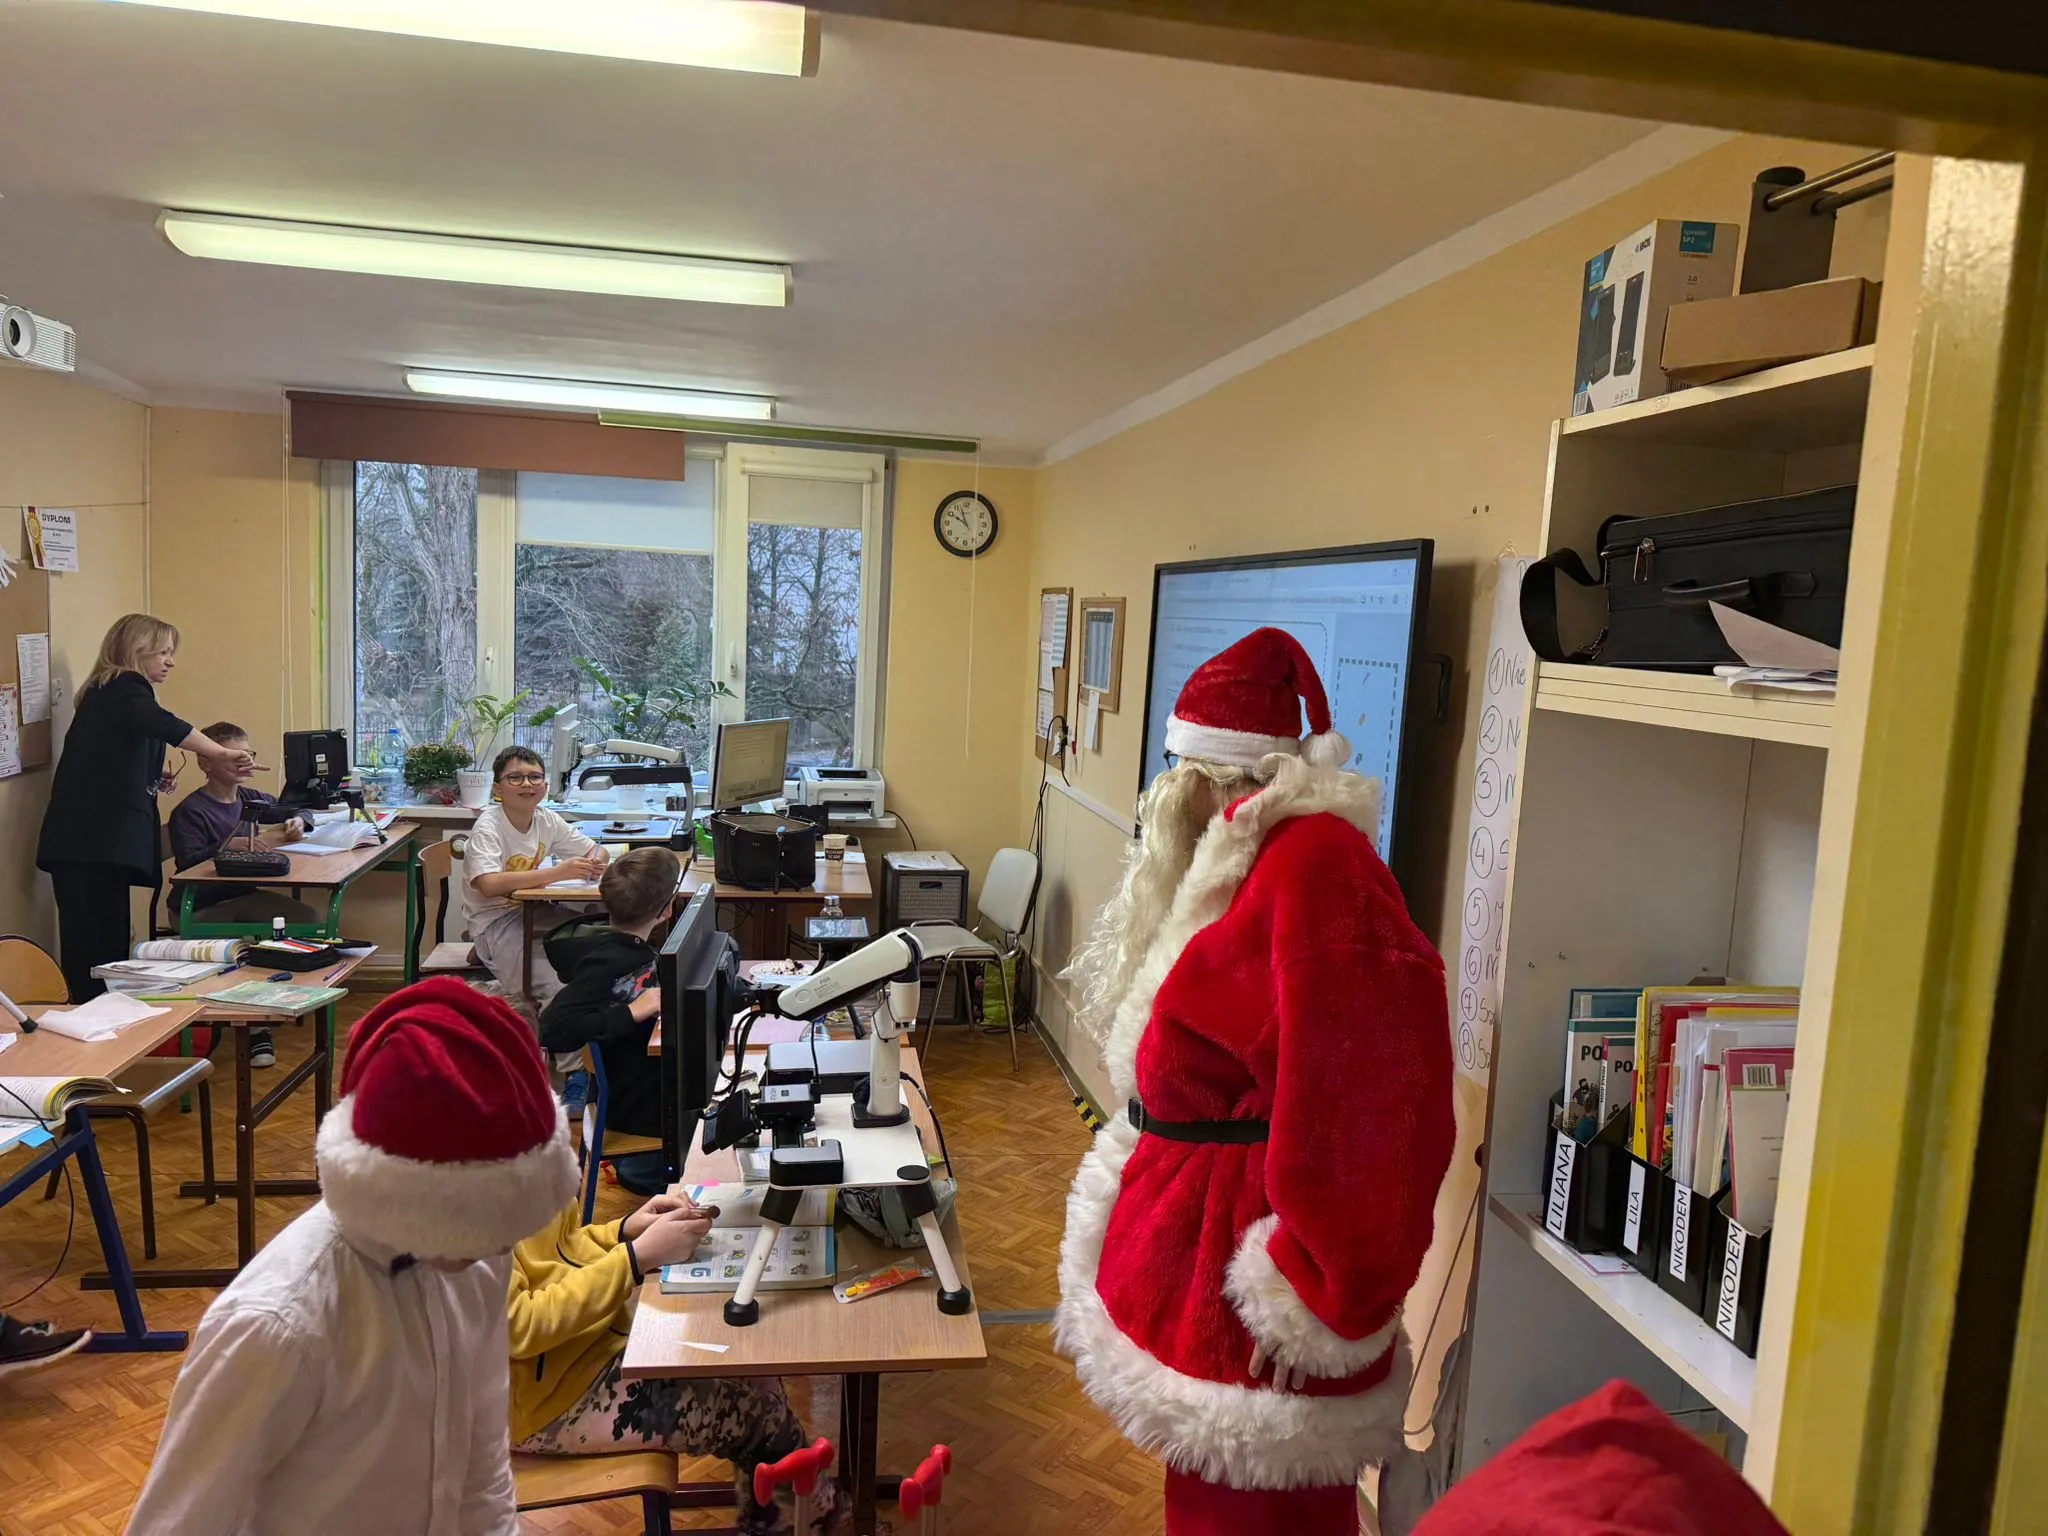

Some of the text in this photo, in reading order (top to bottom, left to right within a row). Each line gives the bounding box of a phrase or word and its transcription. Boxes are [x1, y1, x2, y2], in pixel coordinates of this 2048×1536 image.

[42, 513, 71, 524] DYPLOM
[1549, 1143, 1572, 1231] LILIANA
[1628, 1191, 1640, 1225] LILA
[1673, 1189, 1688, 1275] NIKODEM
[1719, 1222, 1743, 1332] NIKODEM
